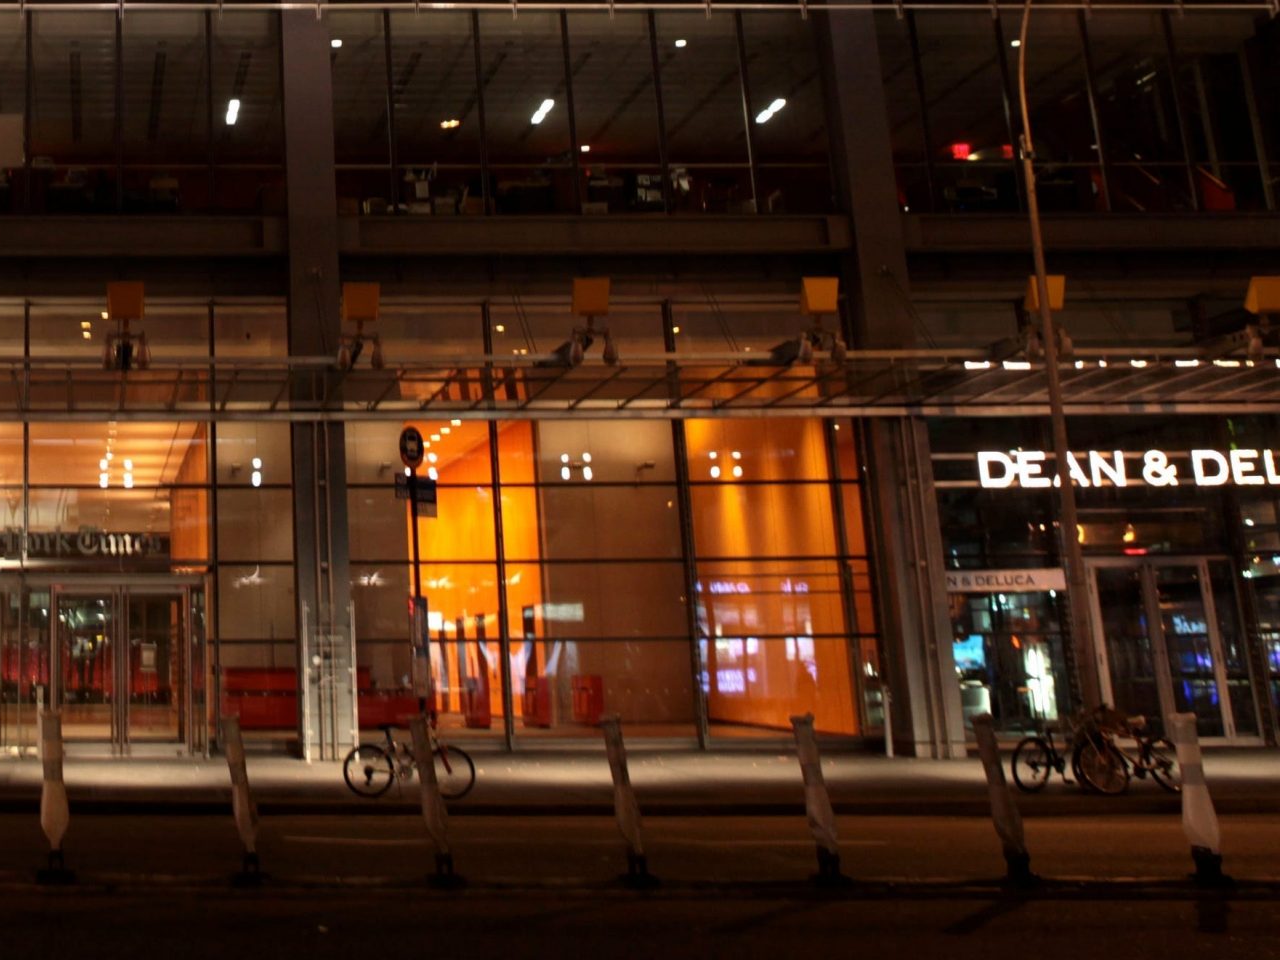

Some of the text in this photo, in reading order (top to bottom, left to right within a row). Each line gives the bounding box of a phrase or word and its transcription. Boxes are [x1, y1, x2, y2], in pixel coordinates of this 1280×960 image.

[977, 450, 1127, 488] DEAN
[1142, 449, 1179, 486] &
[77, 524, 161, 556] Times
[974, 574, 1035, 586] DELUCA
